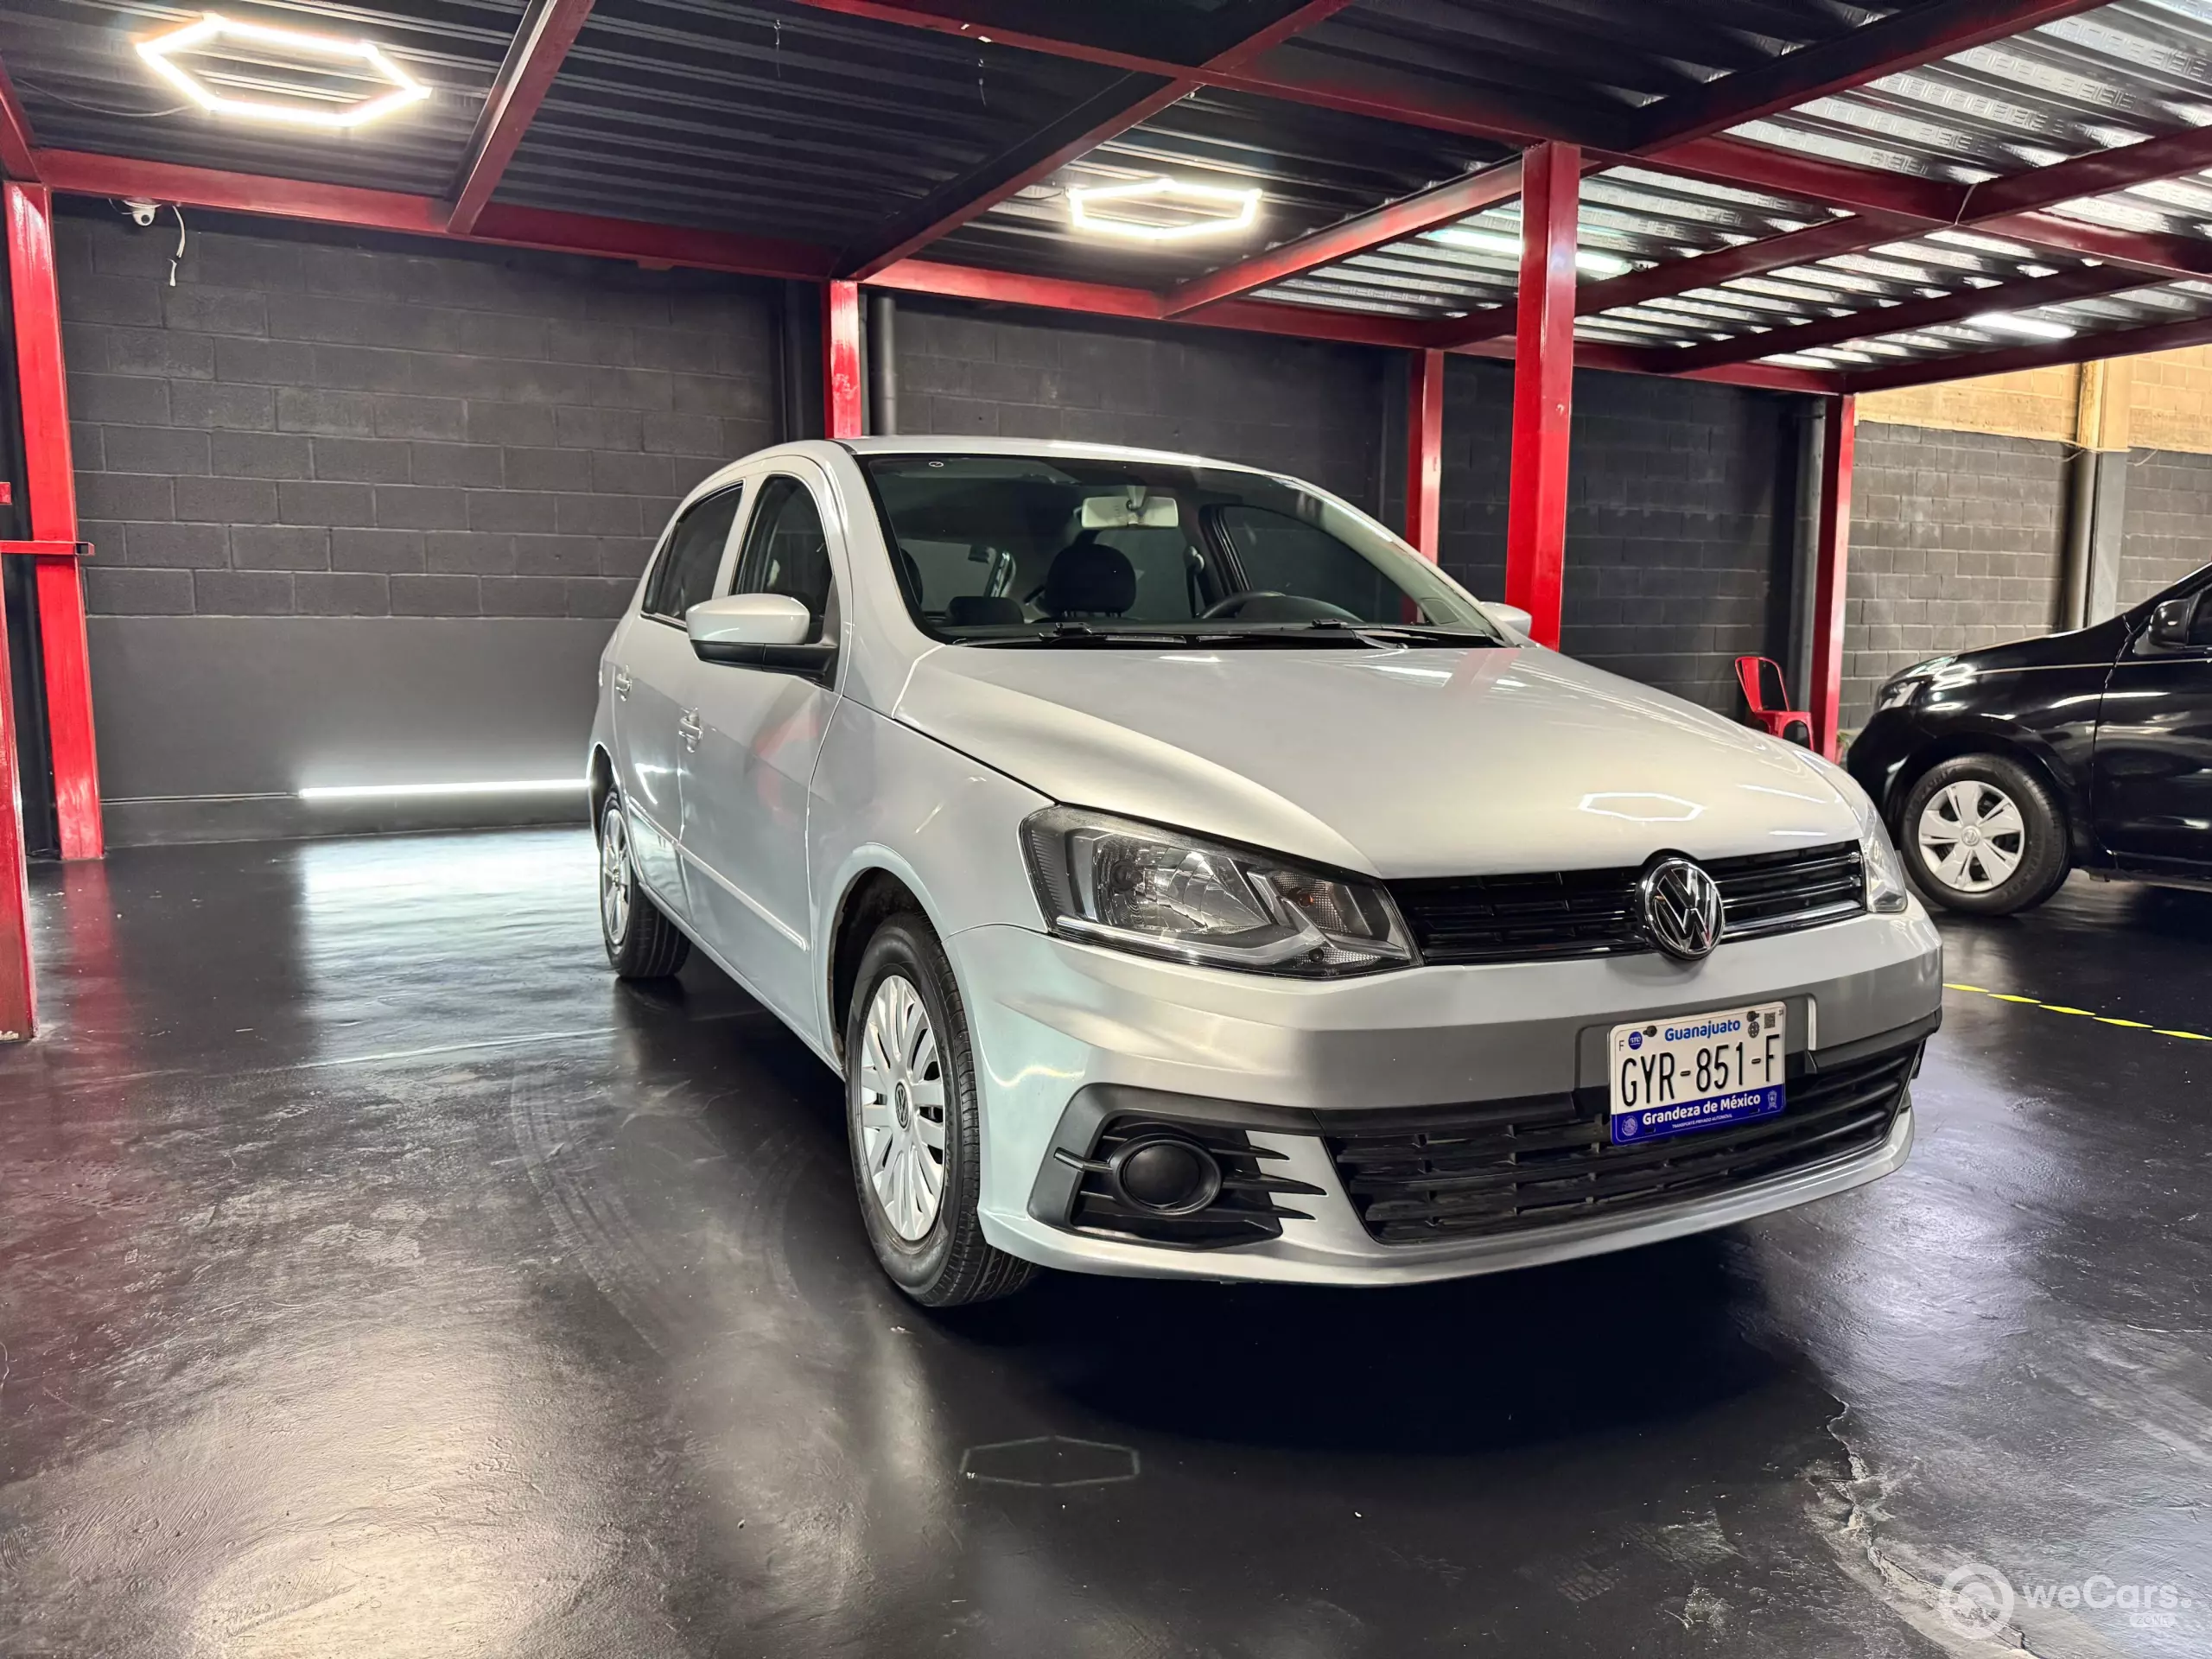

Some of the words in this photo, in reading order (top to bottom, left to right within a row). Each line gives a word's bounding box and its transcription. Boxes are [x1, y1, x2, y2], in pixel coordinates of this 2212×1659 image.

[1664, 1019, 1741, 1042] Guanajuato
[1620, 1033, 1781, 1107] GYR-851-F
[1642, 1106, 1701, 1126] Grandeza
[1702, 1100, 1719, 1115] de
[1719, 1092, 1762, 1111] México
